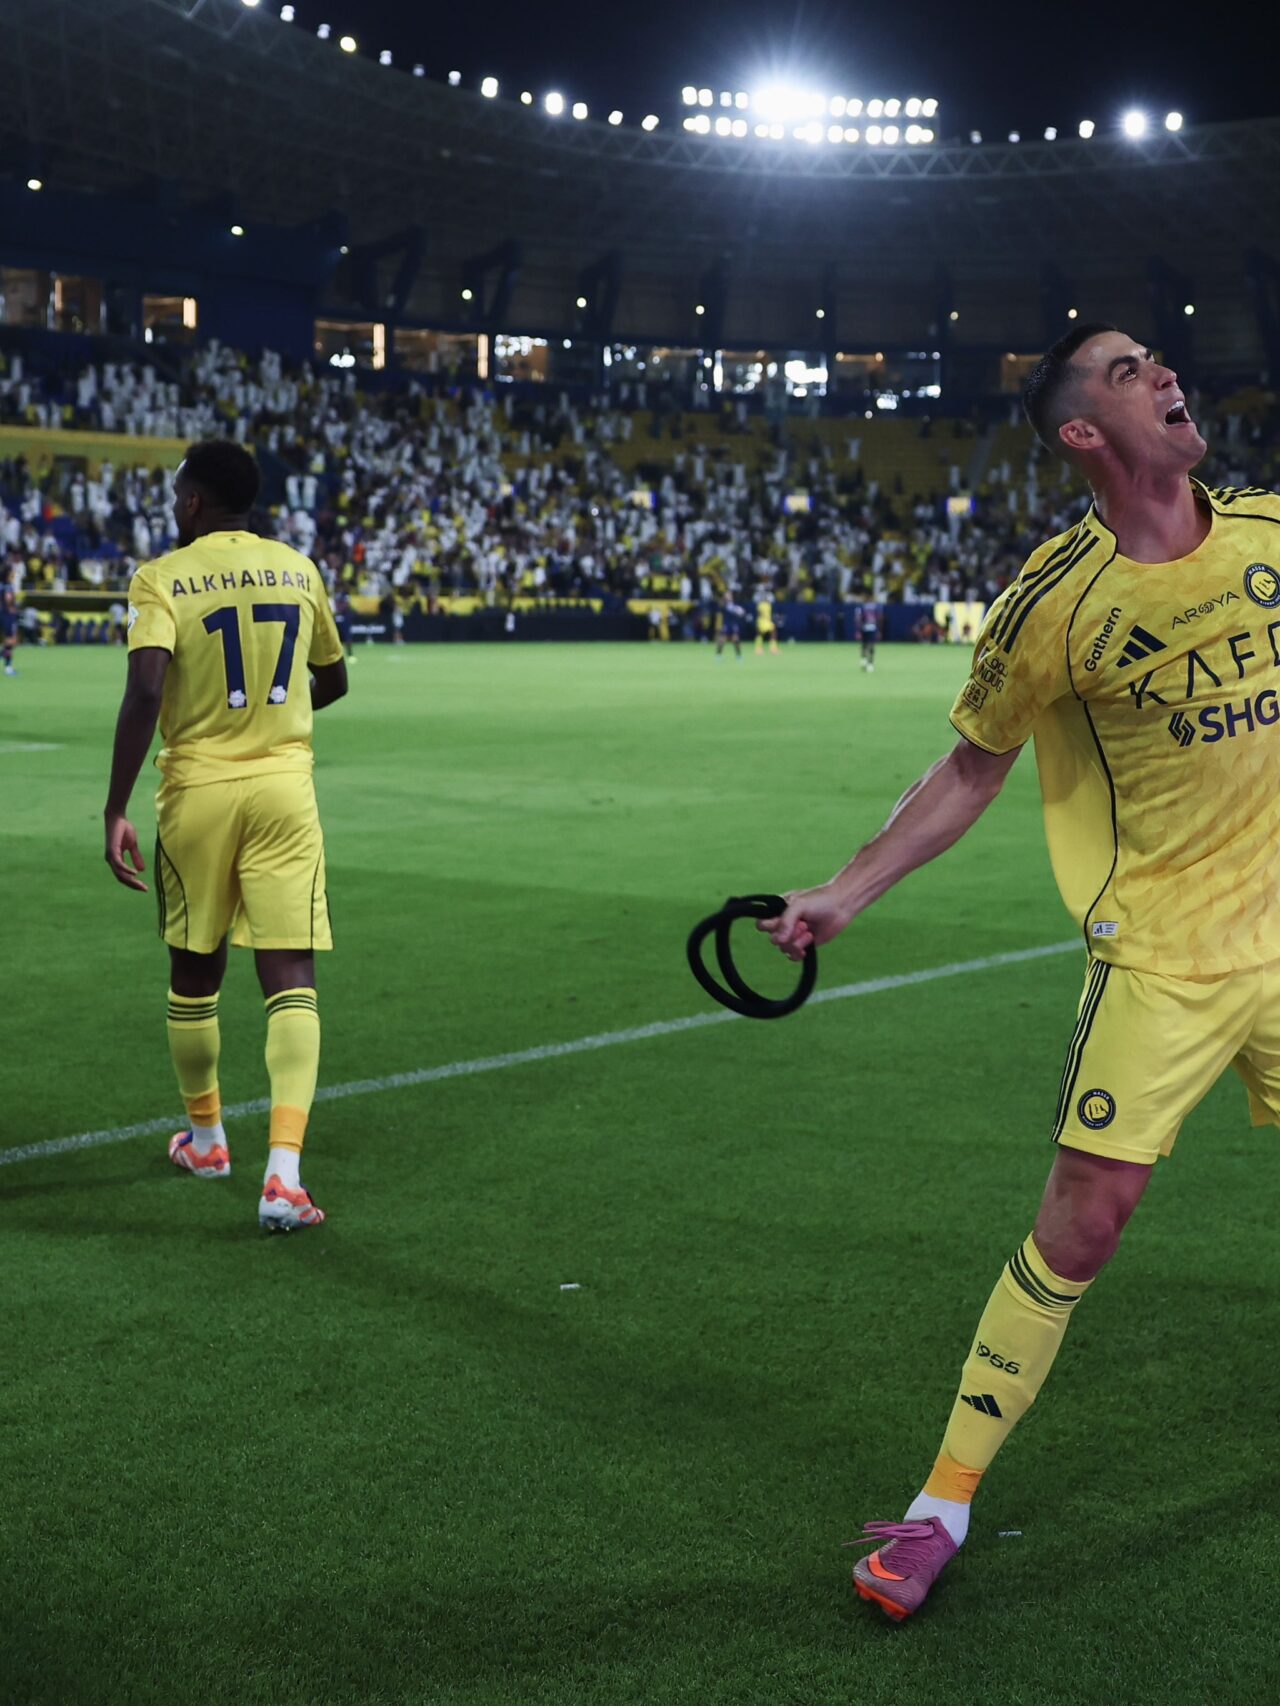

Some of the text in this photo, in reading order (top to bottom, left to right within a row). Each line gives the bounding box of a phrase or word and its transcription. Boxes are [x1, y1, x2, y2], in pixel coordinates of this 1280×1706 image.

[172, 569, 310, 598] ALKHAIBARI
[201, 603, 300, 710] 17
[1084, 606, 1122, 672] Gathern
[1198, 689, 1280, 743] SHG
[976, 1340, 1022, 1375] 1955
